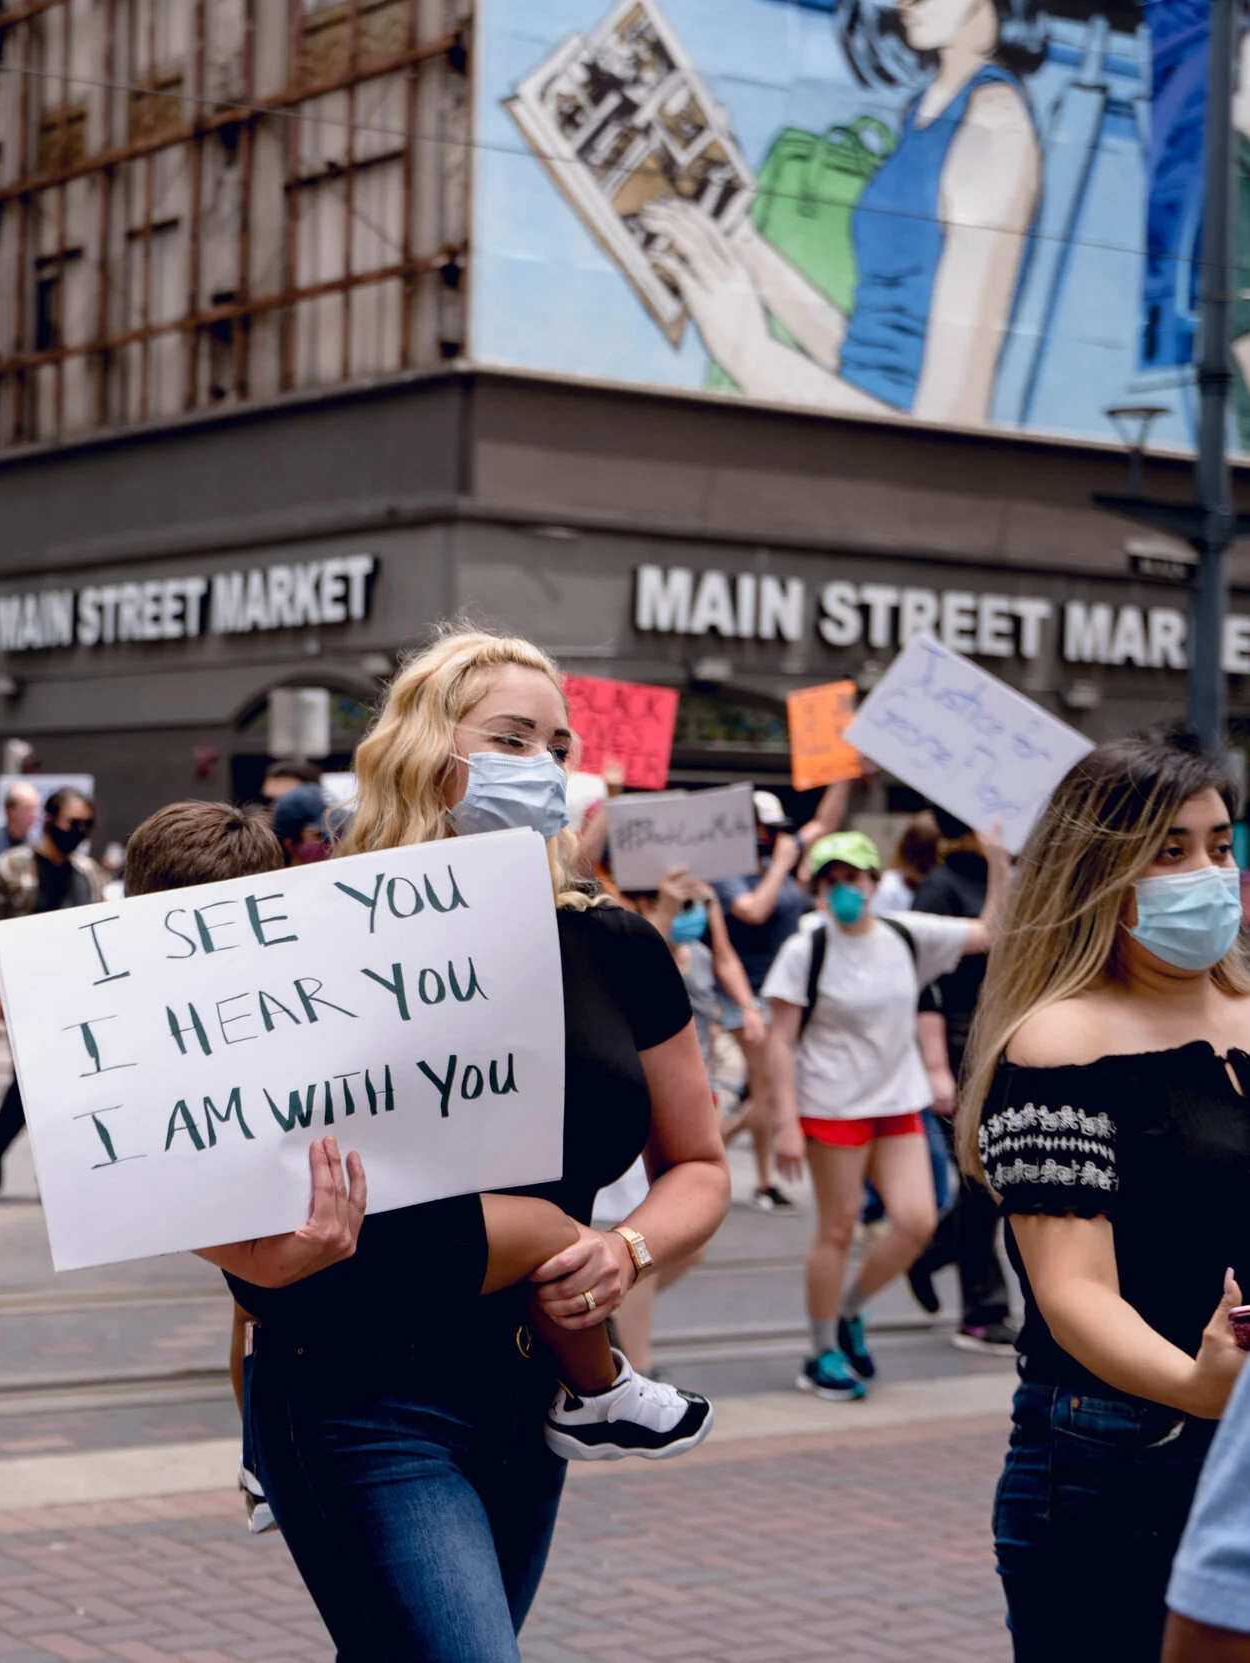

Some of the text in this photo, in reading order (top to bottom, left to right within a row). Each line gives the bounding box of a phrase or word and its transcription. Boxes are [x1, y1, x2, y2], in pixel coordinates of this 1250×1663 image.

[77, 576, 208, 646] STREET
[211, 553, 374, 635] MARKET
[635, 563, 1250, 675] MAIN STREET MARE
[78, 864, 471, 986] I SEE YOU
[61, 956, 489, 1078] I HEAR YOU
[73, 1105, 147, 1170] I
[164, 1086, 256, 1152] AM
[262, 1065, 396, 1135] WITH
